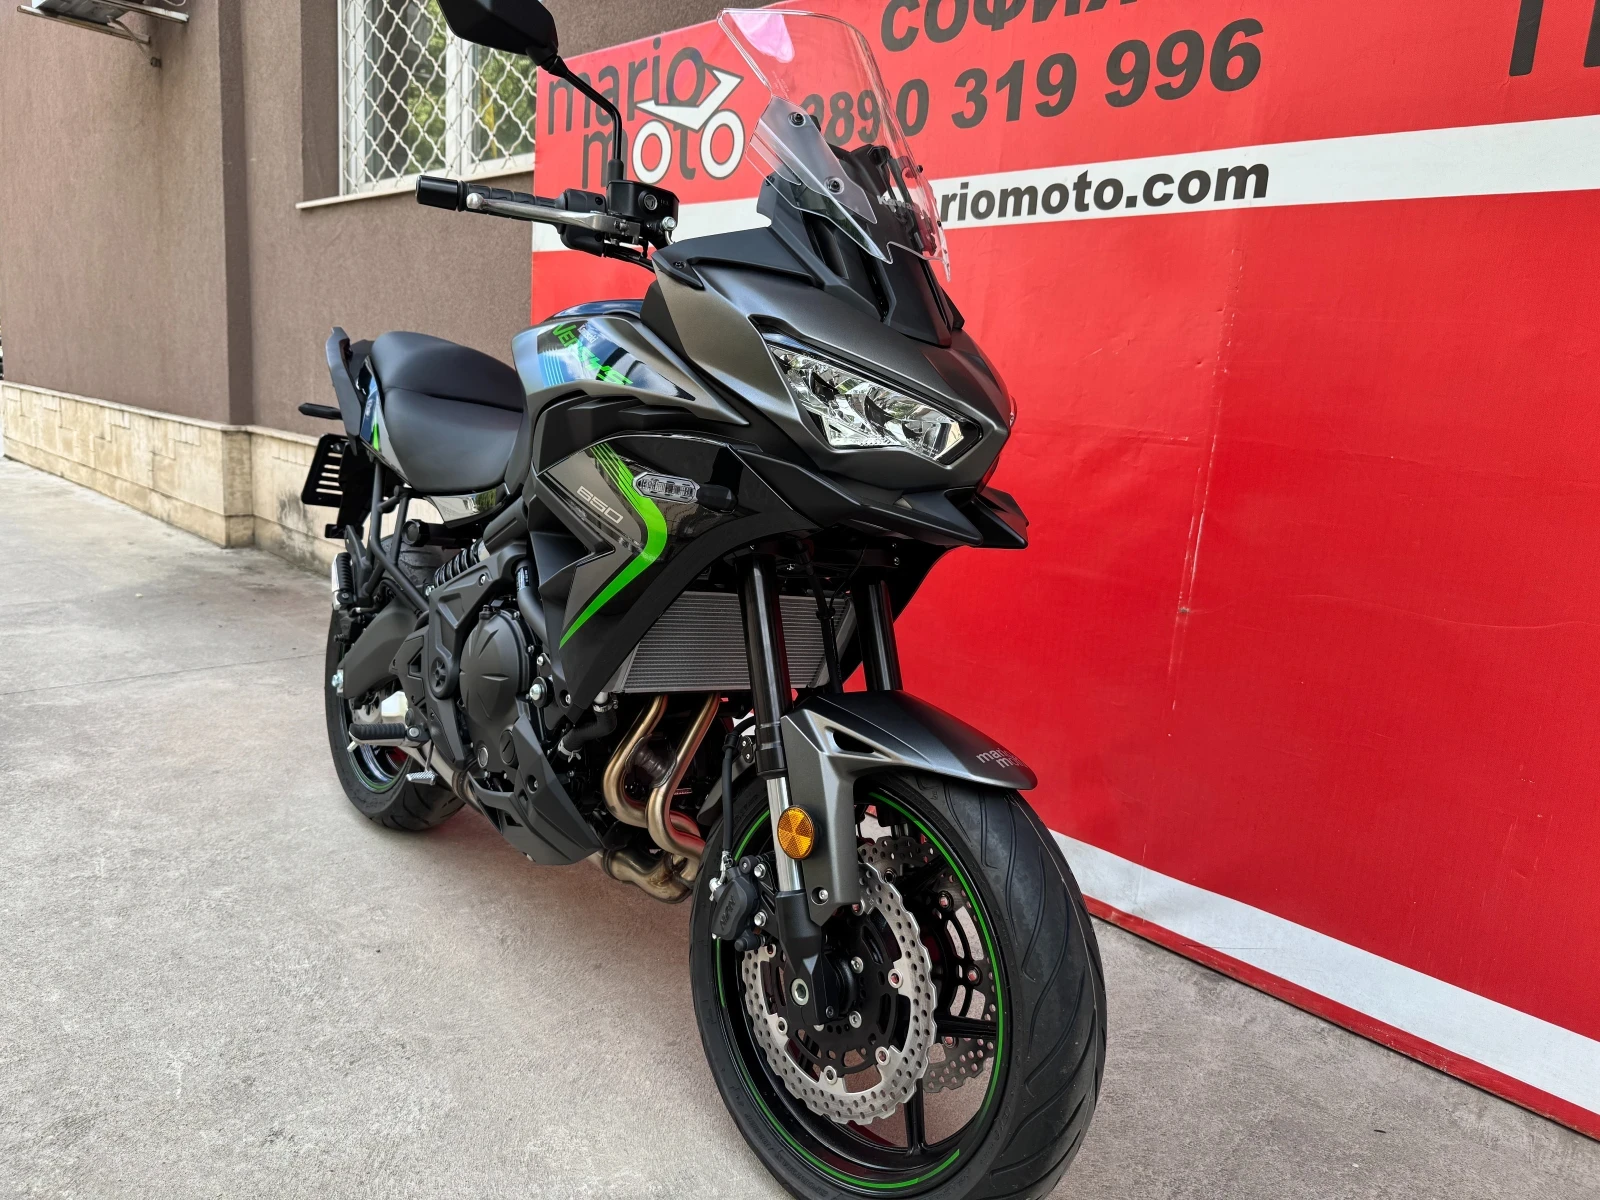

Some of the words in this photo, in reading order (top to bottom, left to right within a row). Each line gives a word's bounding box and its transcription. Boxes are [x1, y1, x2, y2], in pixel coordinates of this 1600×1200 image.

[548, 37, 706, 135] mario
[951, 53, 1077, 129] 319
[1104, 18, 1264, 108] 996
[582, 108, 745, 189] moto
[577, 486, 623, 524] 650
